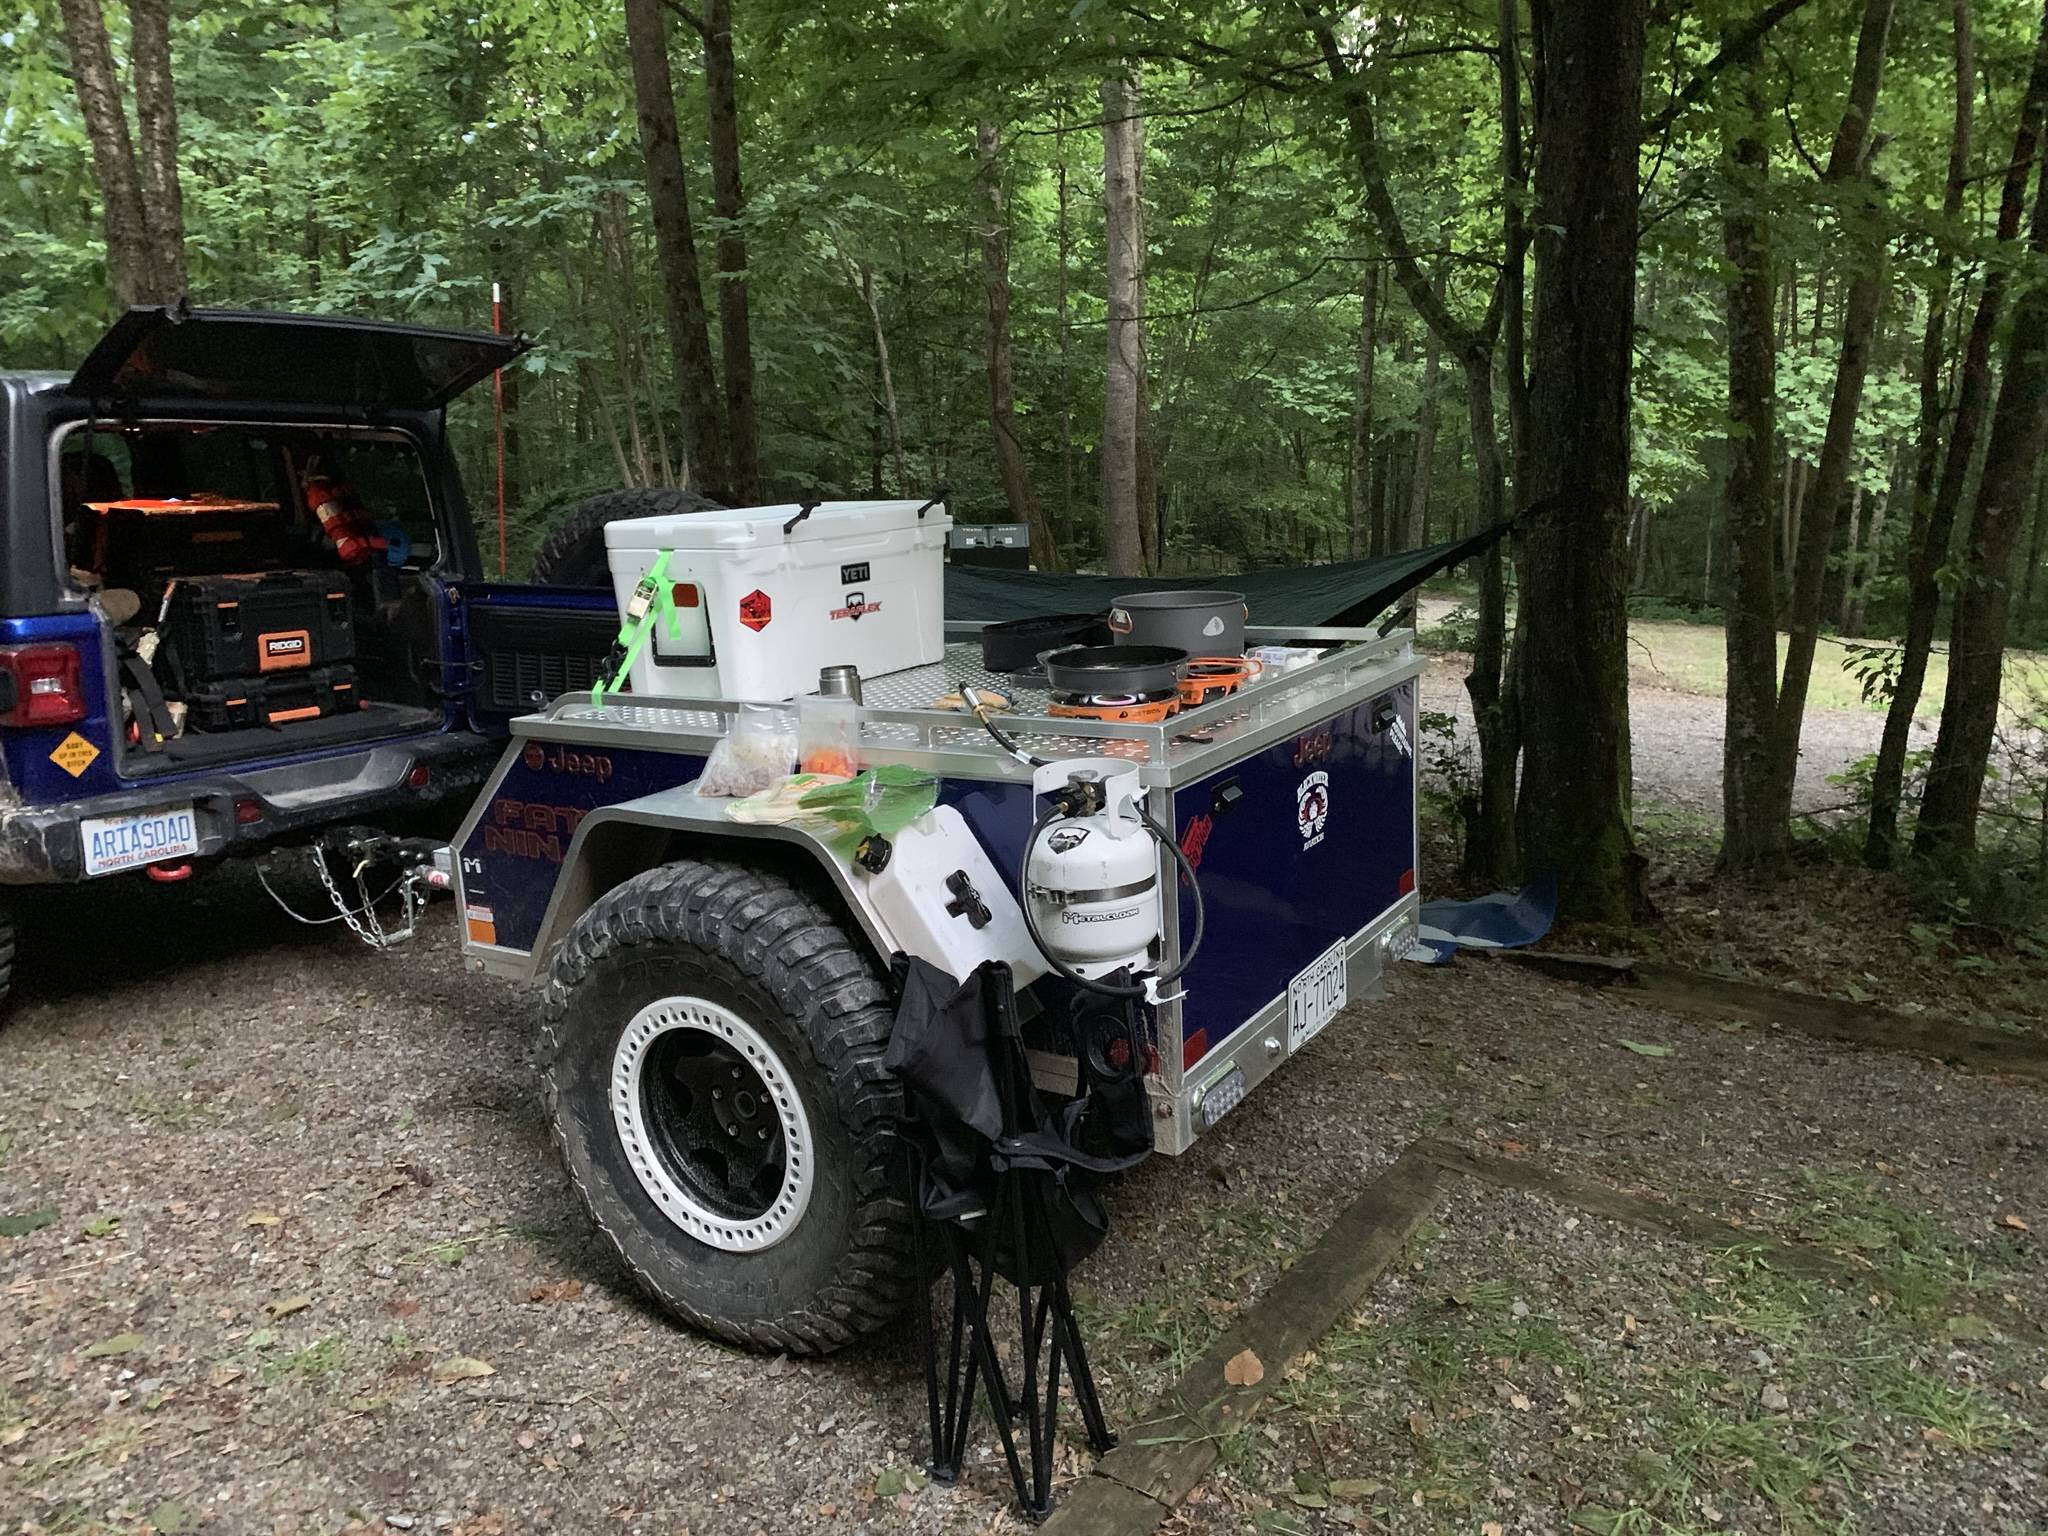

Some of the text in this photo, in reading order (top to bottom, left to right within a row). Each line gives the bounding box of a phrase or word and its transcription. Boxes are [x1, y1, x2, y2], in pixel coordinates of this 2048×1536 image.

[842, 566, 869, 582] YETI
[829, 601, 882, 621] TERAFLEX
[269, 640, 302, 651] RIDGID
[548, 746, 613, 784] Jeep
[93, 815, 192, 860] ARIASDAD
[97, 843, 187, 868] NORTH CAROLINA
[1293, 946, 1344, 998] NORTH CAROLINA
[1292, 960, 1345, 1037] AJ-77024
